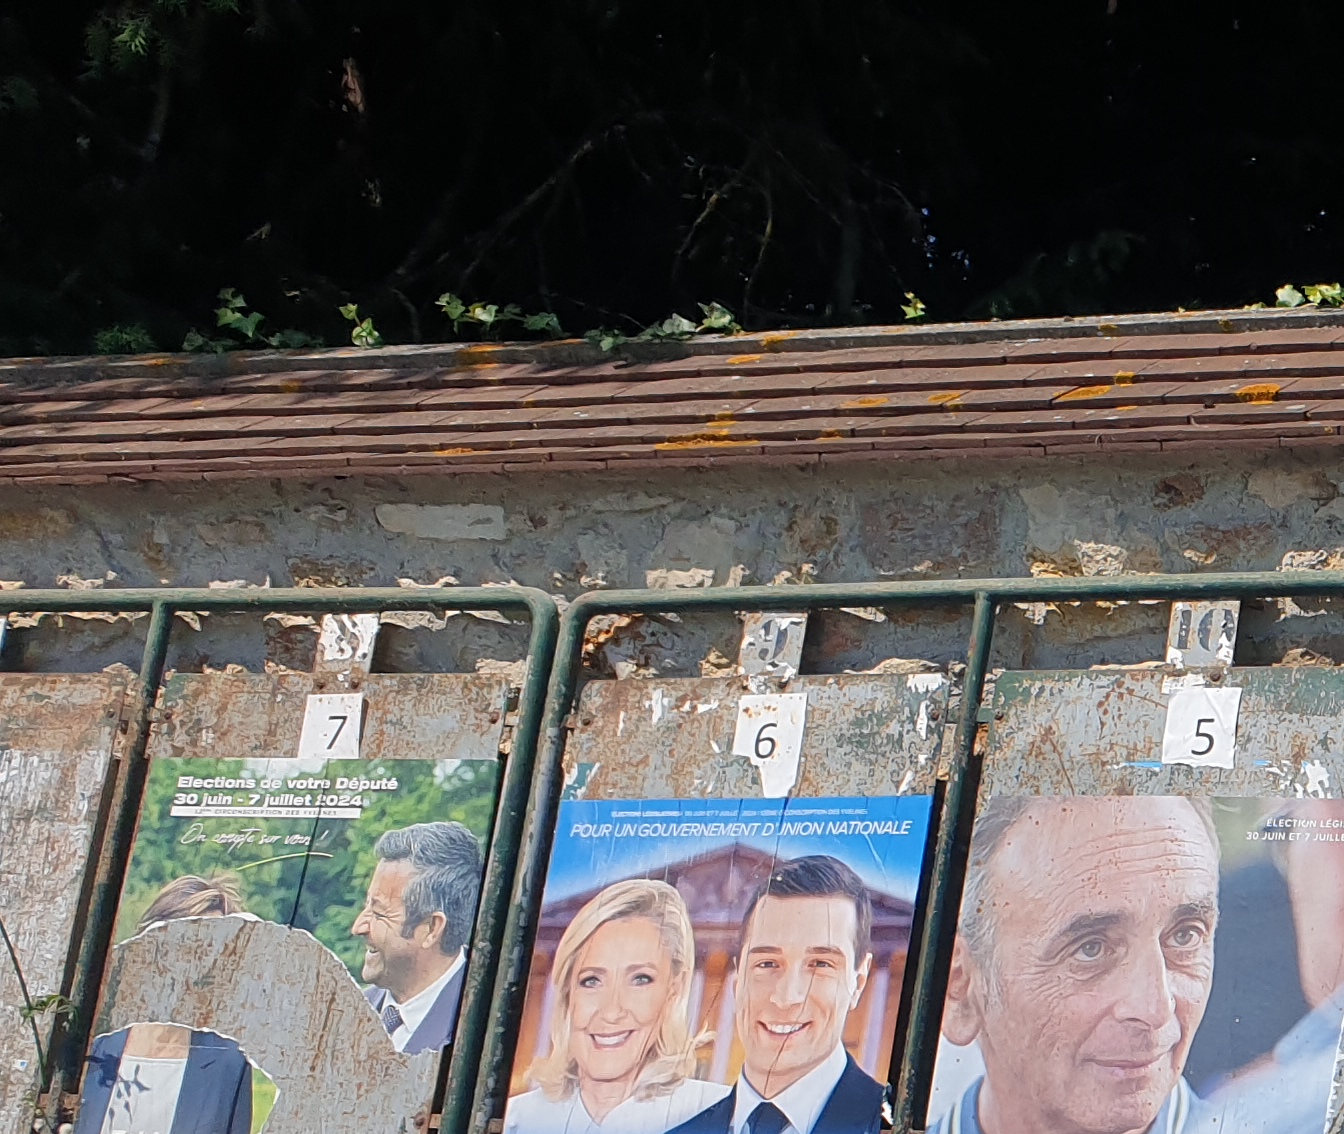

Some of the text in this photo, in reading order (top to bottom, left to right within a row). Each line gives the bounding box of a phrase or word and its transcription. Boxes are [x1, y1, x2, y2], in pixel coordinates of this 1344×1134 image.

[327, 716, 348, 750] 7
[755, 722, 778, 758] 6
[1191, 718, 1215, 755] 5
[178, 776, 398, 793] Elections Député
[174, 794, 311, 807] 30 juin juillet
[570, 823, 612, 837] POUR
[615, 823, 640, 837] UN
[641, 822, 761, 837] GOUVERNEMENT
[826, 821, 912, 836] NATIONALE
[1246, 832, 1259, 840] 30
[1261, 832, 1286, 841] JUIN
[1289, 832, 1300, 840] ET
